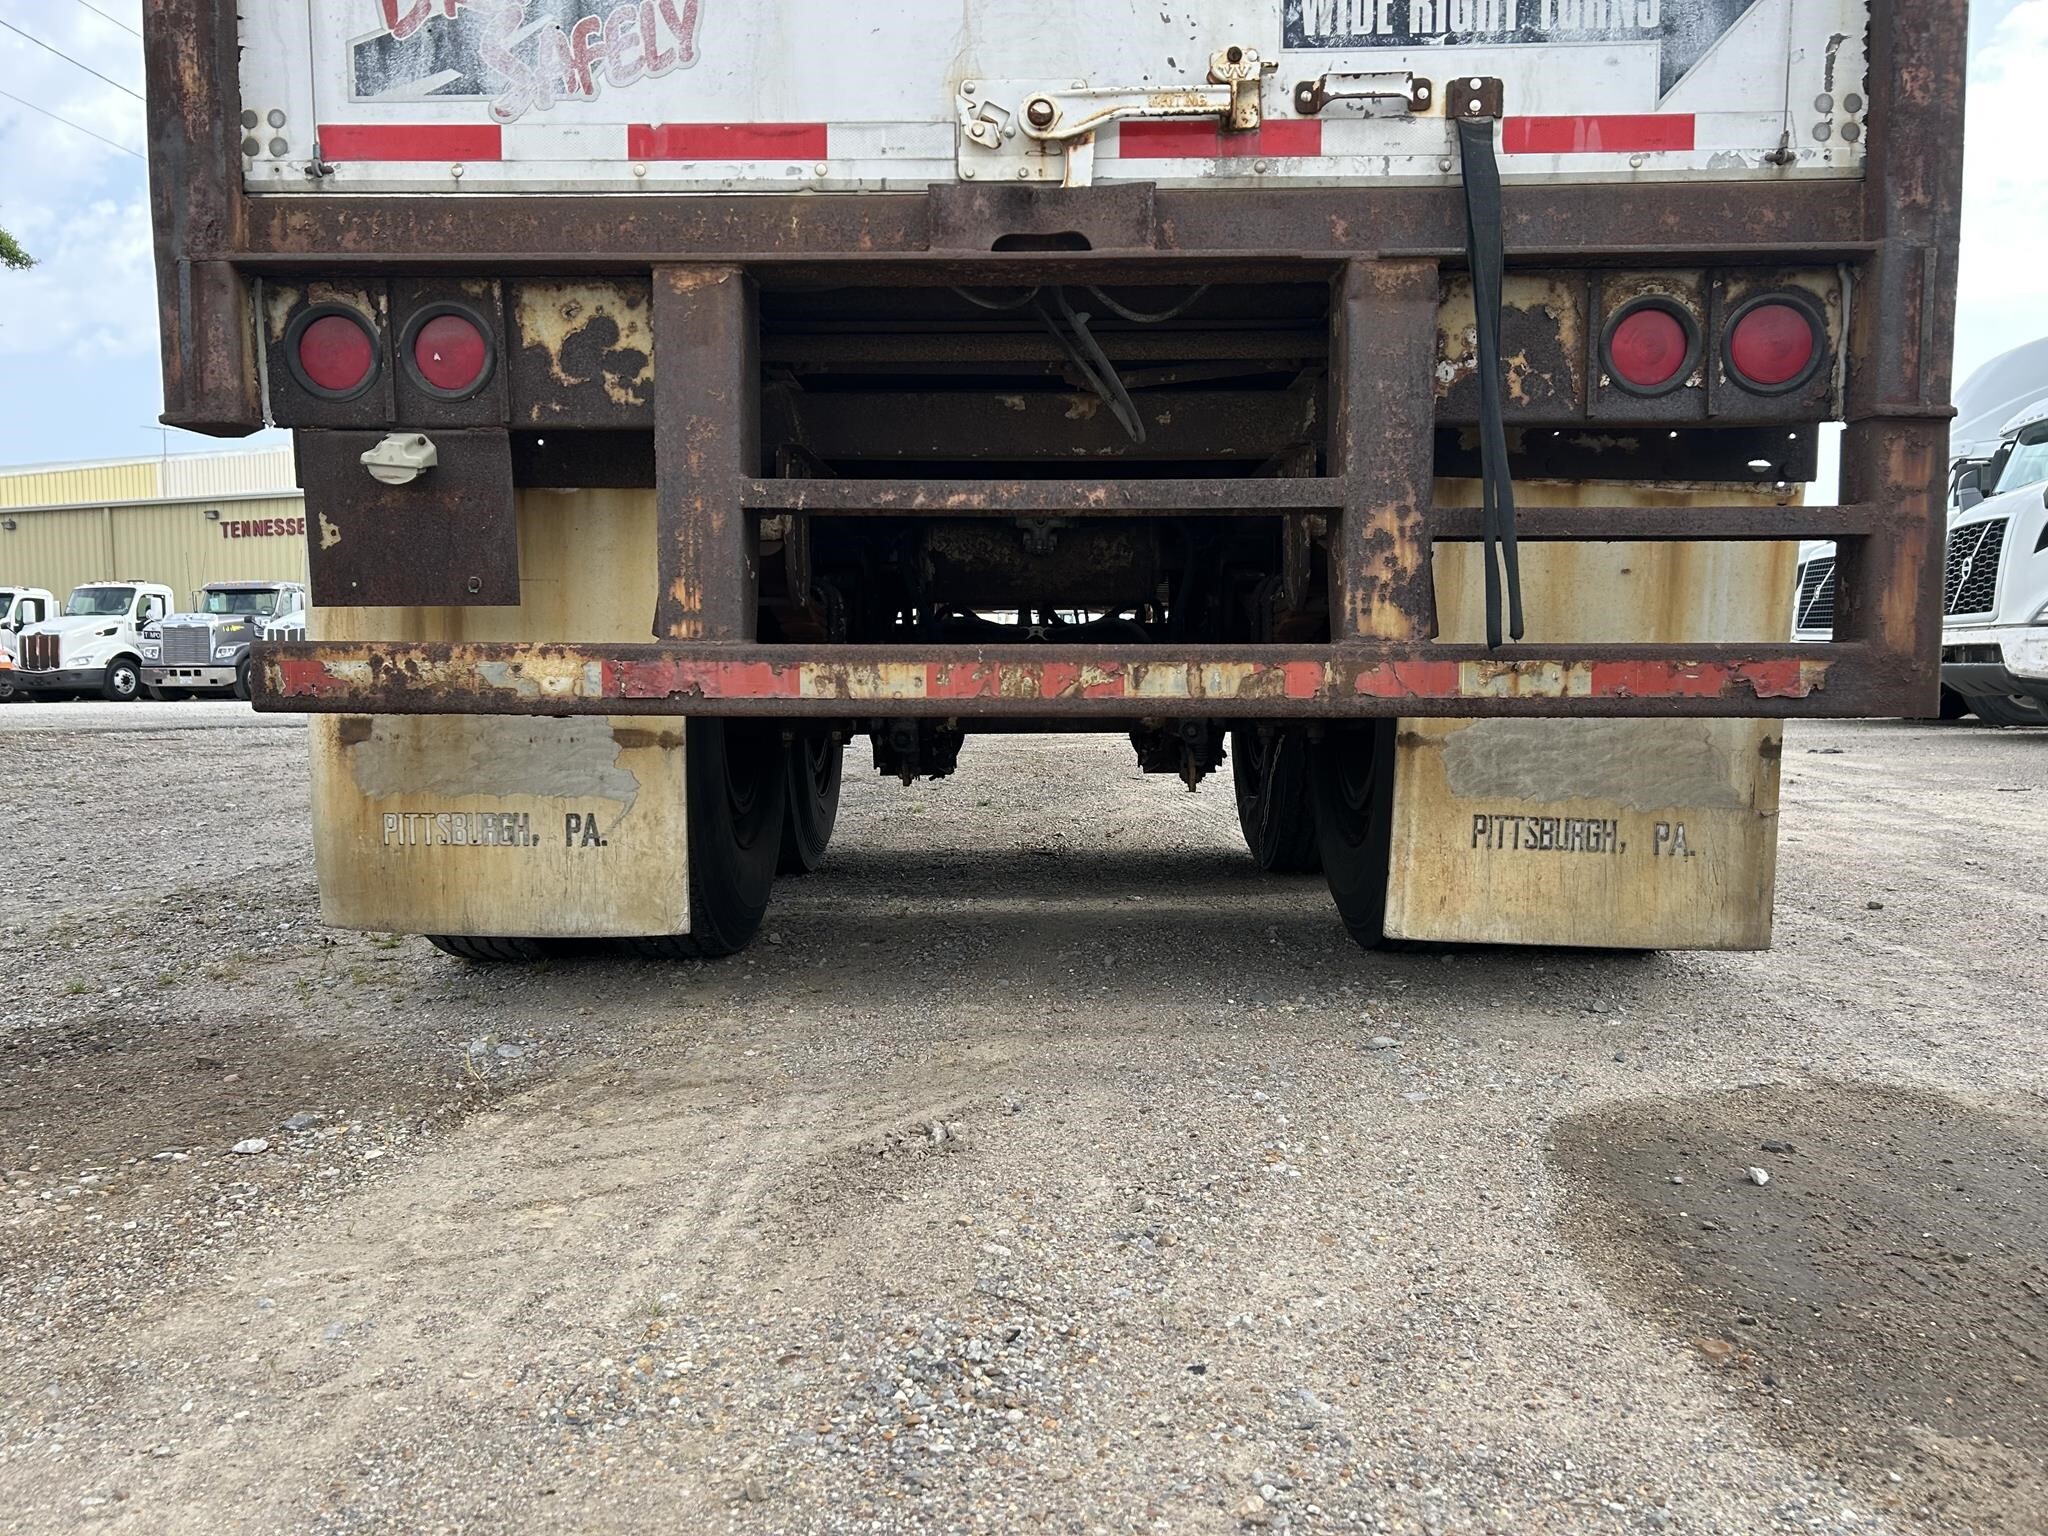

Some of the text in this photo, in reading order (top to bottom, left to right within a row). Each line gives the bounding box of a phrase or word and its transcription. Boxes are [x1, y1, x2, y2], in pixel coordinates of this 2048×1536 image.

[481, 0, 699, 121] SAFELY
[220, 517, 305, 539] TENNESSE
[382, 812, 608, 847] PITTSBURGH, PA.
[1471, 813, 1696, 857] PITTSBURGH, PA.
